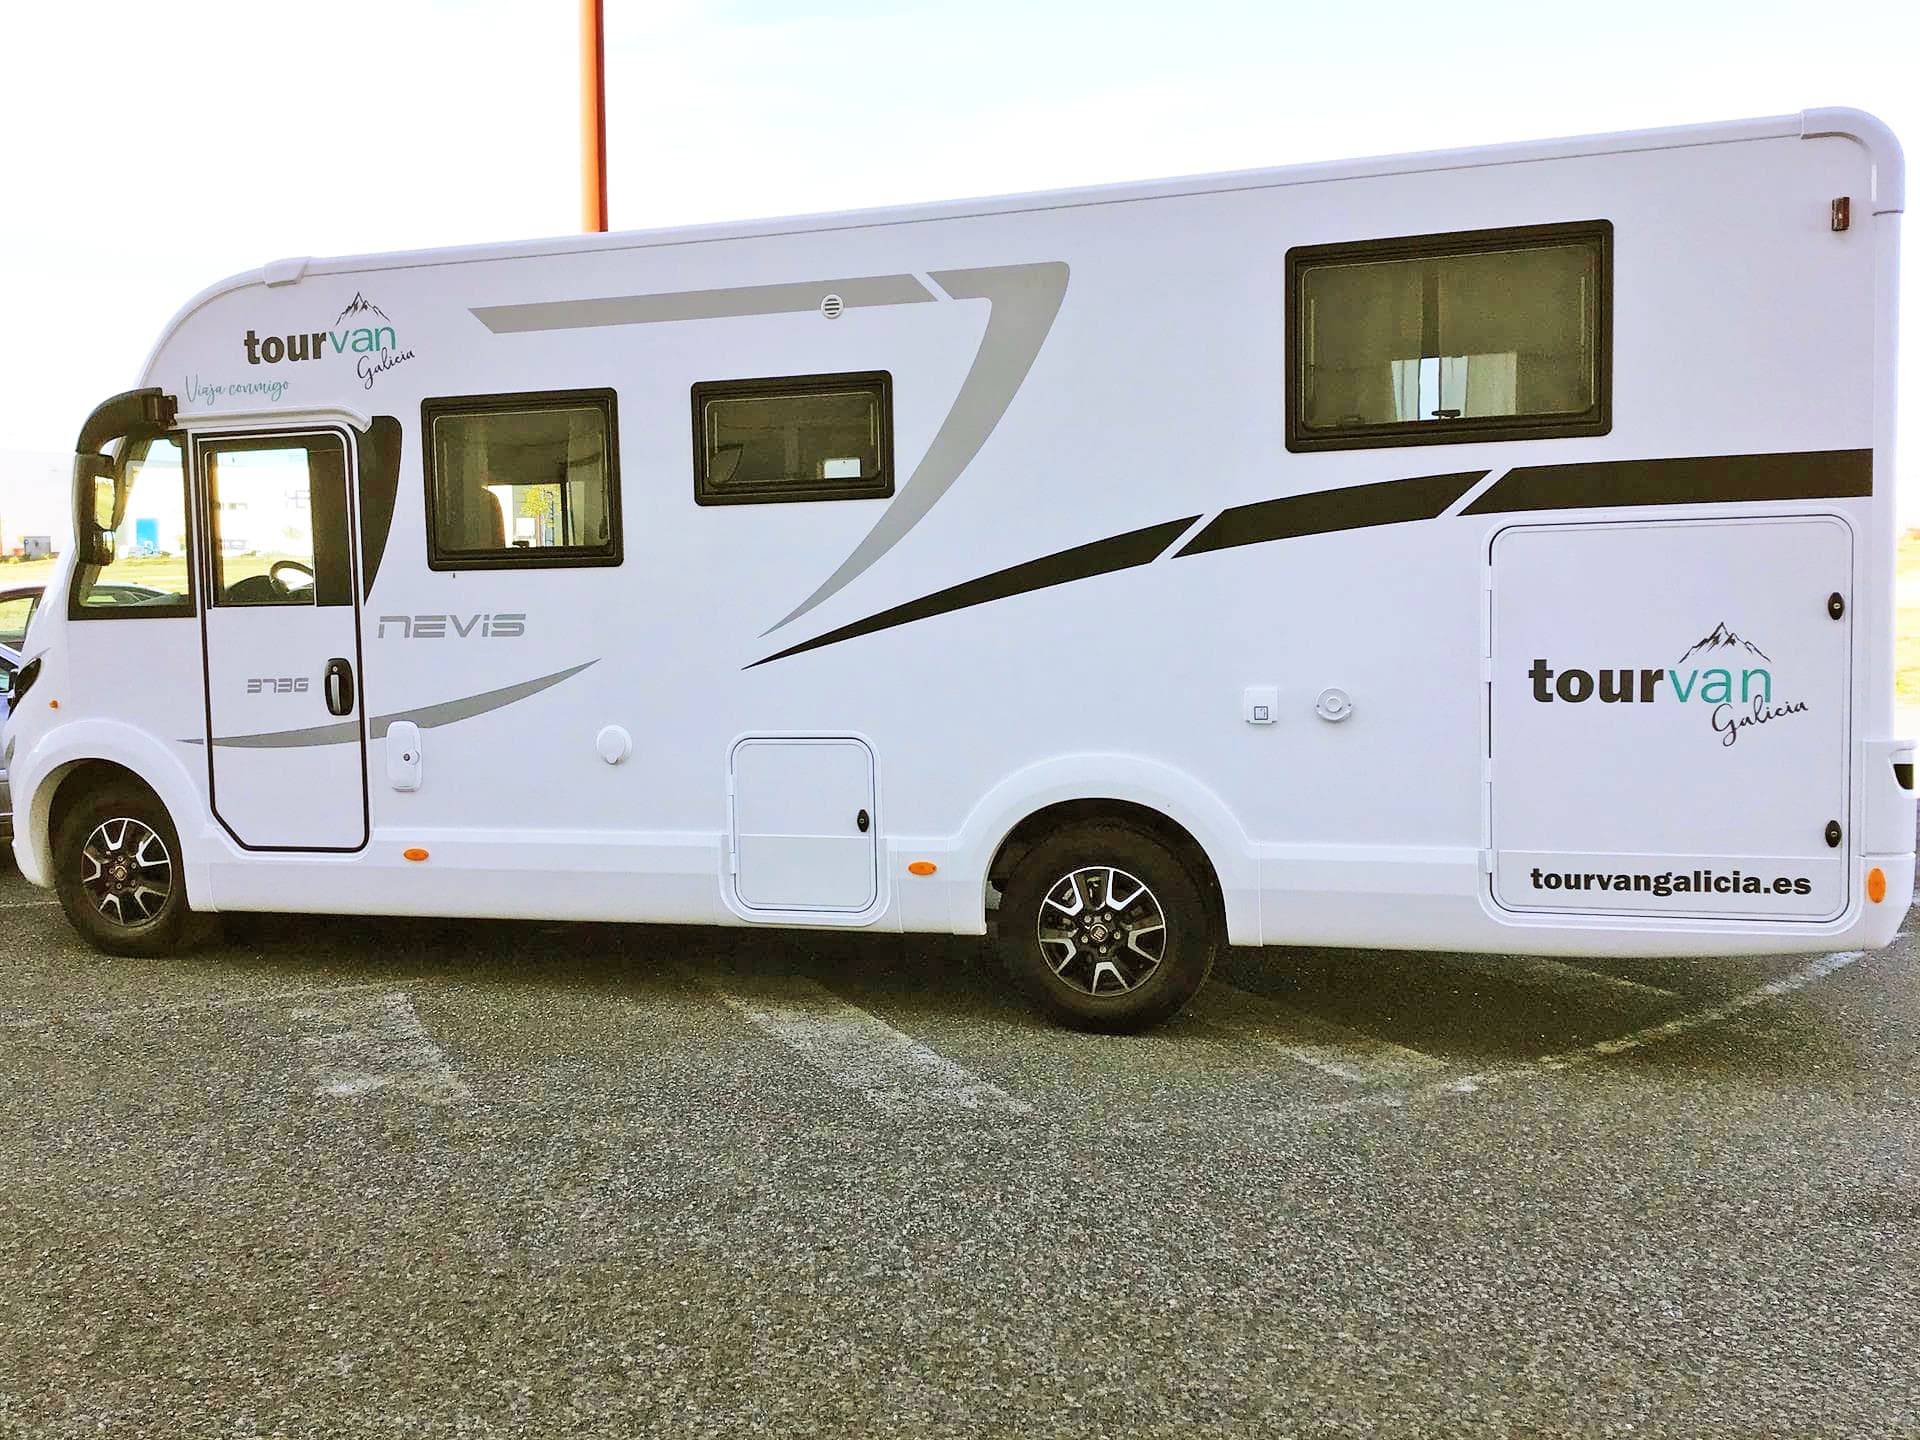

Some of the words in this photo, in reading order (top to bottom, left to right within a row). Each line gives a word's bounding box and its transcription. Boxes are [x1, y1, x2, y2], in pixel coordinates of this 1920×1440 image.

[244, 325, 397, 364] tourvan
[356, 347, 415, 390] Galicia
[229, 379, 291, 401] conmigo
[1528, 659, 1772, 703] tourvan
[1711, 694, 1809, 747] Galicia
[1530, 868, 1812, 897] tourvangalicia.es
